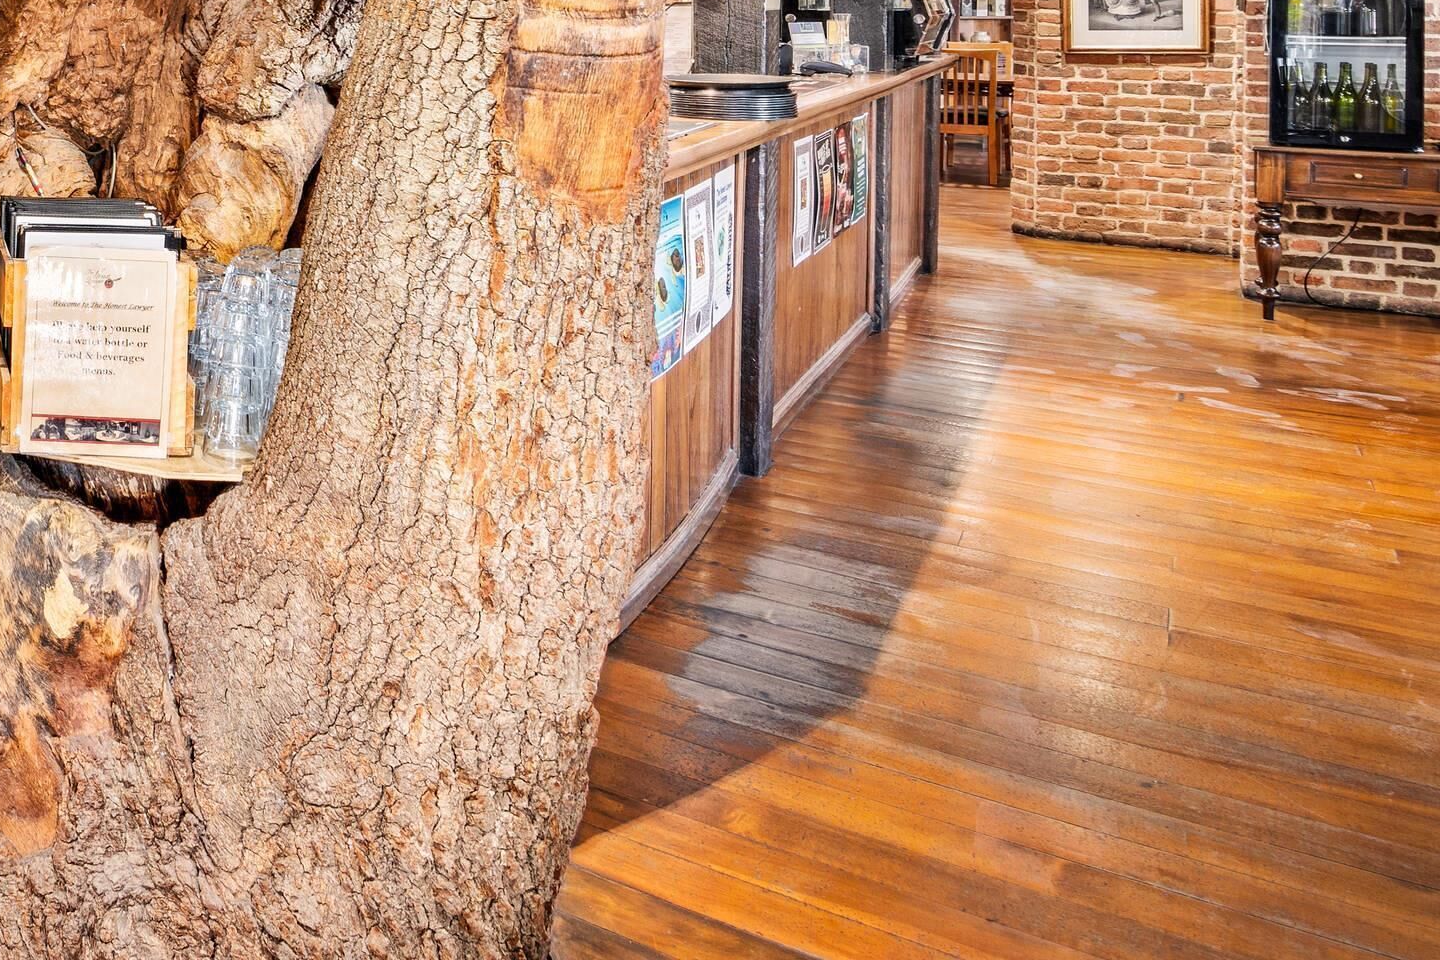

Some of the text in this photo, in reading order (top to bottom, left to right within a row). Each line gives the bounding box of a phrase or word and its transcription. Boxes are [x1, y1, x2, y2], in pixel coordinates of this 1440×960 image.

[52, 299, 80, 308] Welcome
[102, 302, 127, 311] Honest
[128, 303, 155, 312] Lawyer
[110, 323, 151, 335] yourself
[104, 337, 134, 348] bottle
[136, 340, 148, 349] or
[96, 351, 145, 364] beverages
